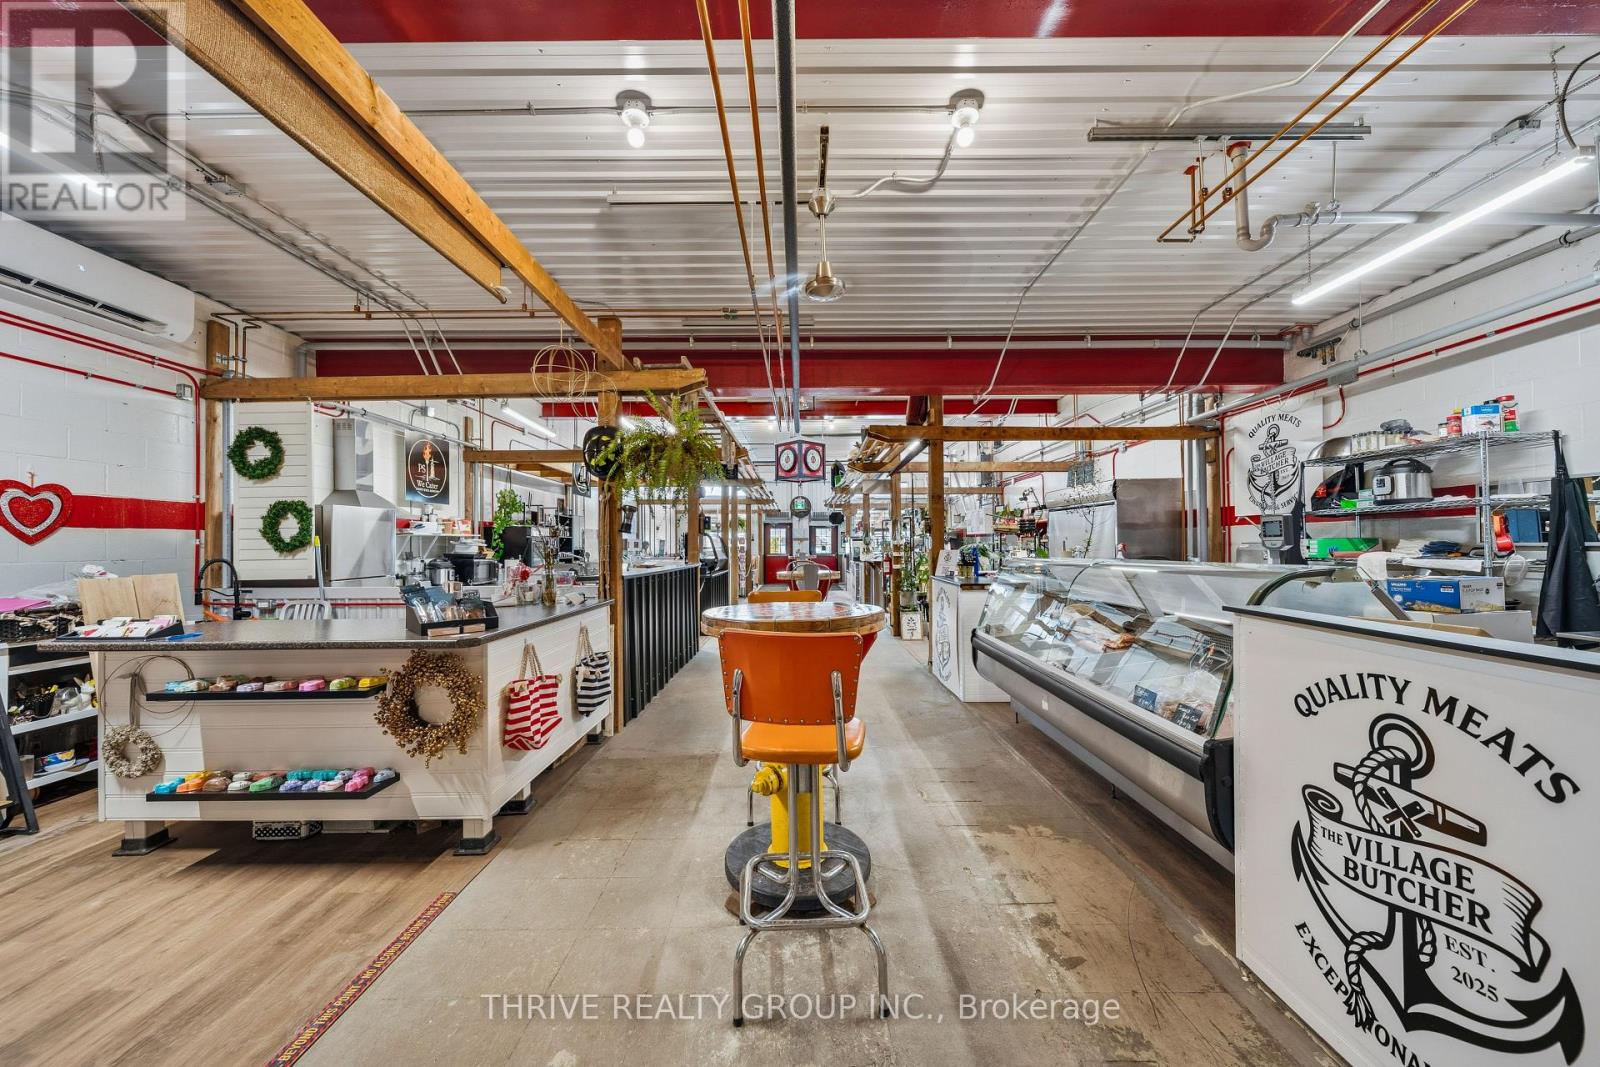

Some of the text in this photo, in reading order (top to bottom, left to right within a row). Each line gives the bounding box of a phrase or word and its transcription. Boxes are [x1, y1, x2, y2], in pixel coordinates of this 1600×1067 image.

[1248, 413, 1302, 439] QUALITY MEATS
[1294, 672, 1582, 804] QUALITY MEATS
[1320, 825, 1476, 894] THE VILLAGE
[1342, 855, 1493, 934] BUTCHER
[1443, 934, 1496, 973] EST.
[1451, 966, 1499, 1004] 2025
[278, 1027, 319, 1061] BEYOND
[313, 1008, 338, 1026] THIS
[333, 984, 362, 1006] POINT
